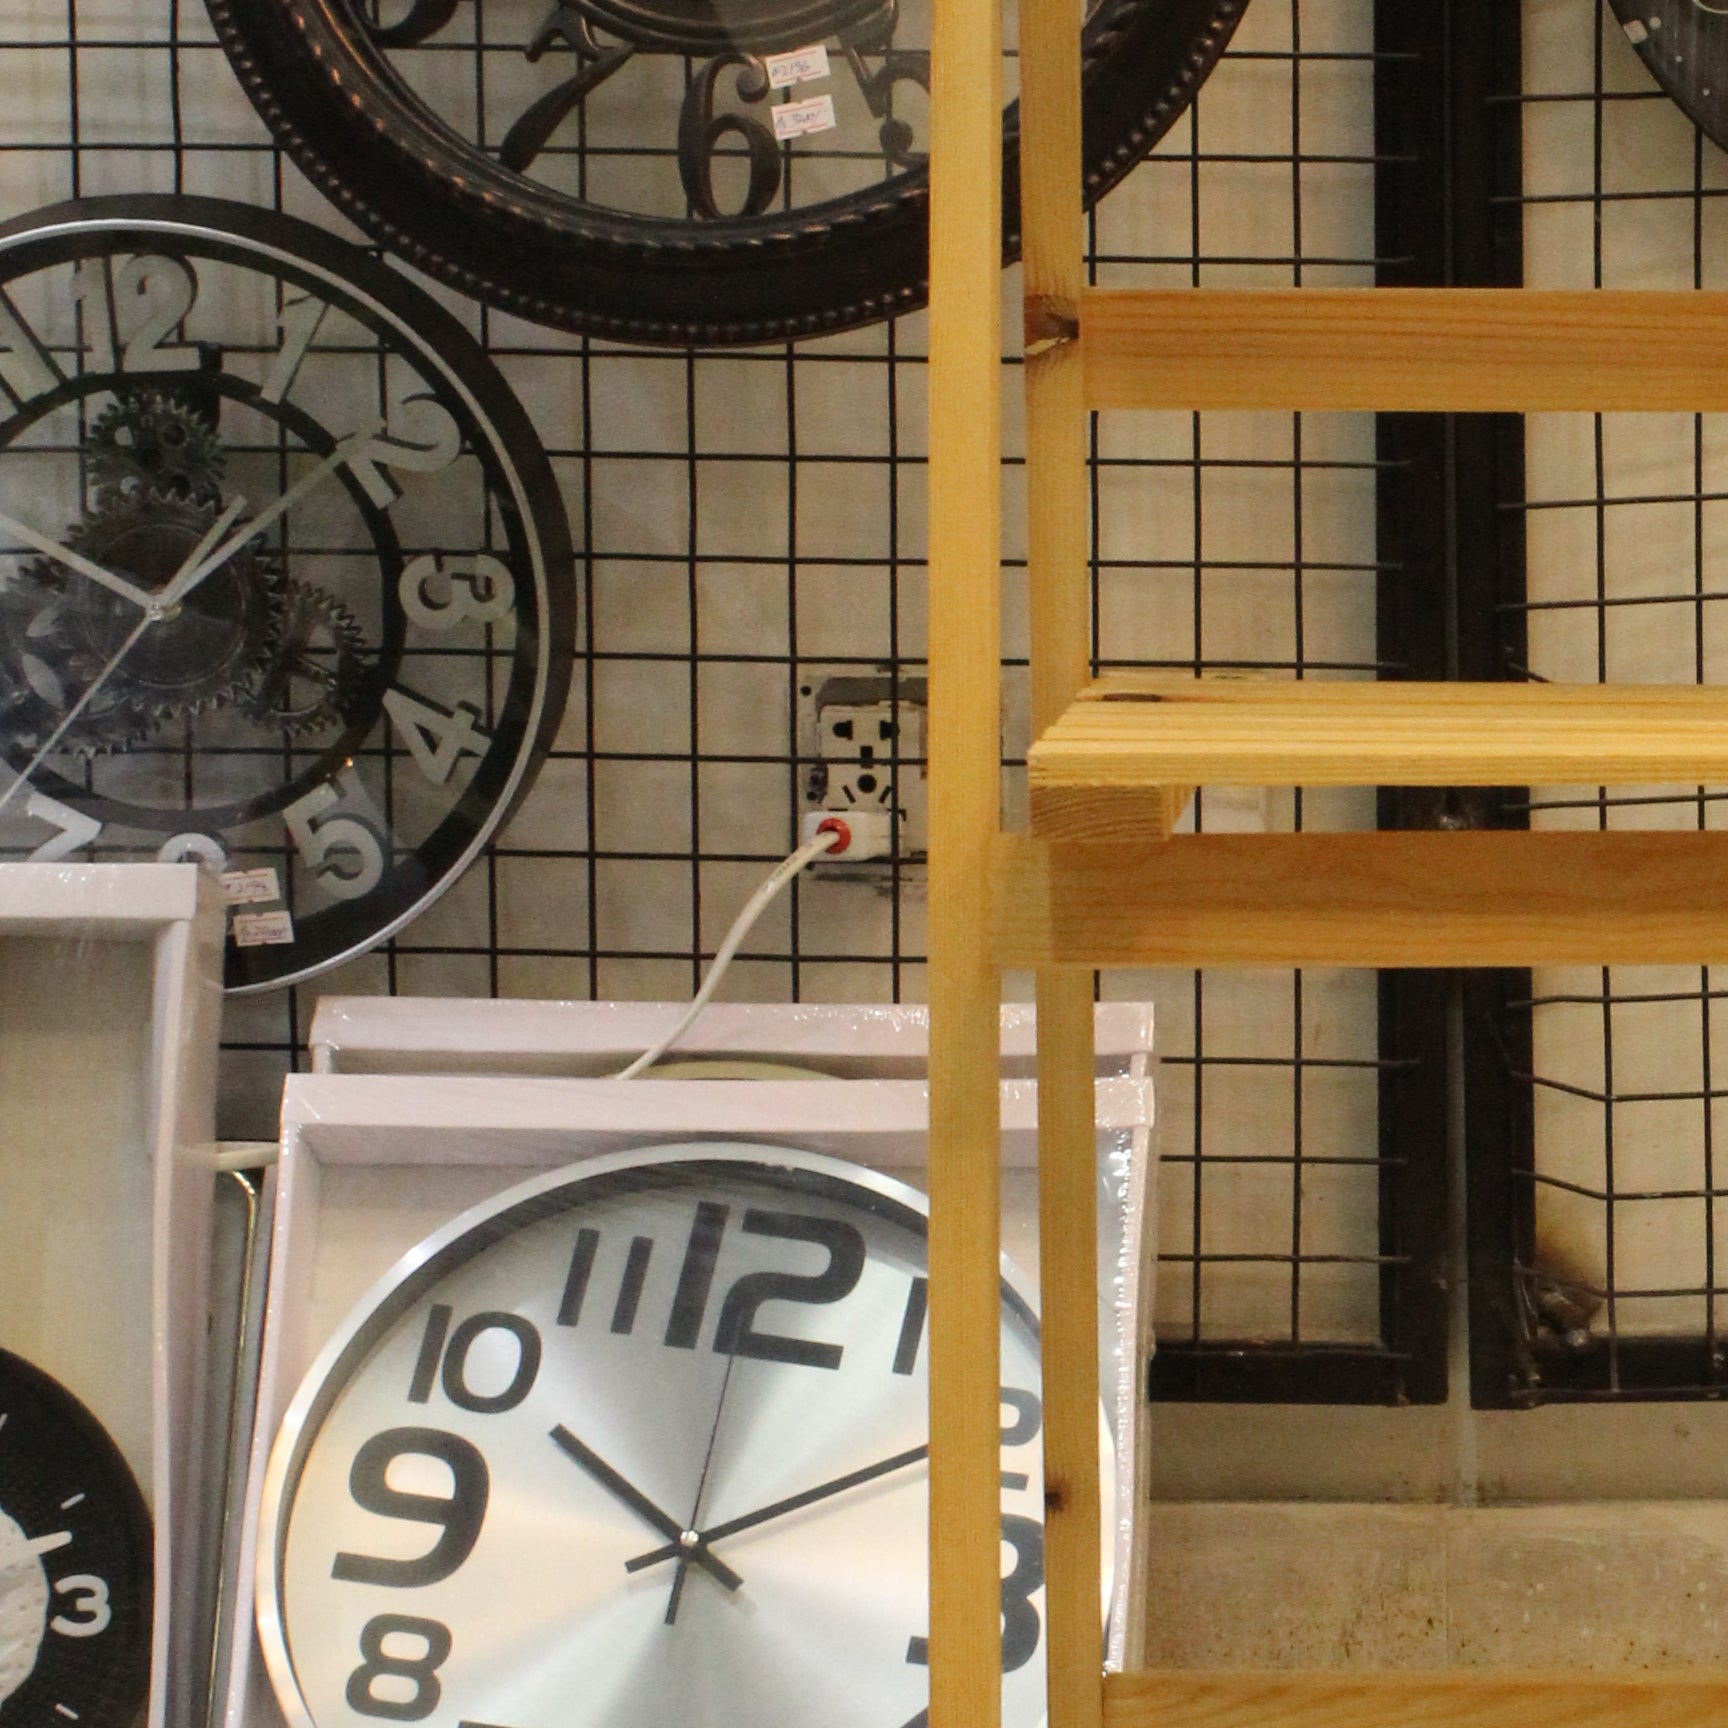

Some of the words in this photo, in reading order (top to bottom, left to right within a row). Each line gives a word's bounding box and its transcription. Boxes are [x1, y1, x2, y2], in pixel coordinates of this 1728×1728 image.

[678, 51, 782, 222] 6
[406, 1304, 543, 1415] 10
[662, 1201, 867, 1371] 12
[330, 1425, 491, 1590] 9
[344, 1612, 454, 1723] 8
